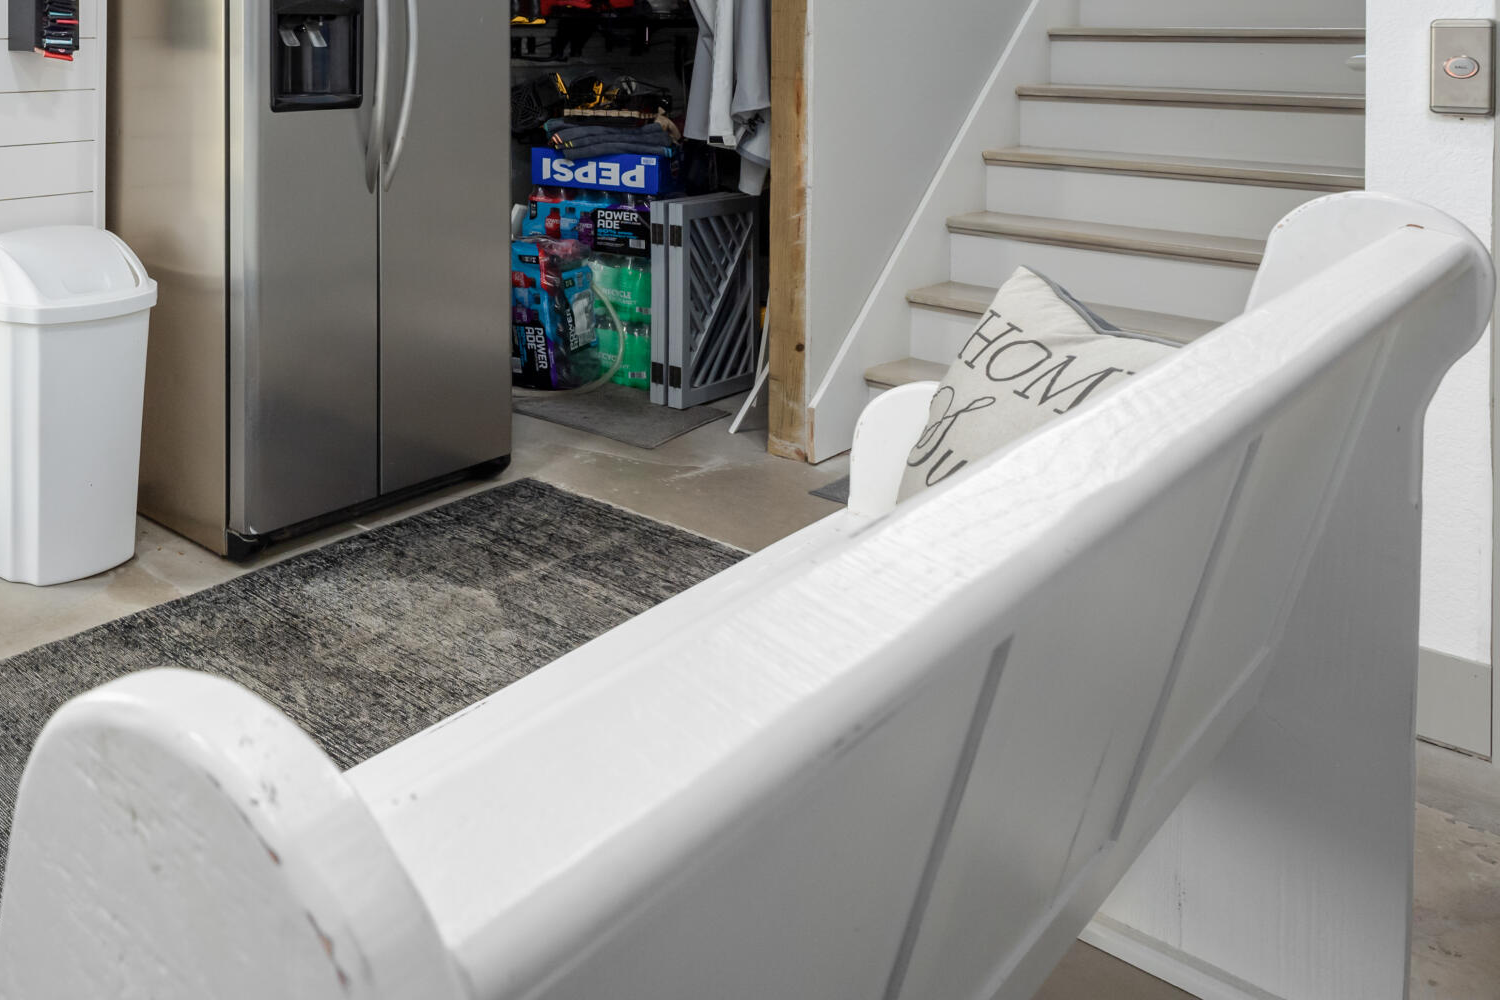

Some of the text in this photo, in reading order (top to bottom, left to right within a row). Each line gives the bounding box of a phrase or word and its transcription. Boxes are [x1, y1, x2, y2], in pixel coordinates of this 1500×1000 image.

[542, 157, 645, 189] PEPSI
[597, 210, 639, 222] POWER
[597, 220, 620, 230] ADE
[525, 326, 536, 350] ADE
[534, 327, 548, 369] POWER
[957, 309, 1135, 414] HOM
